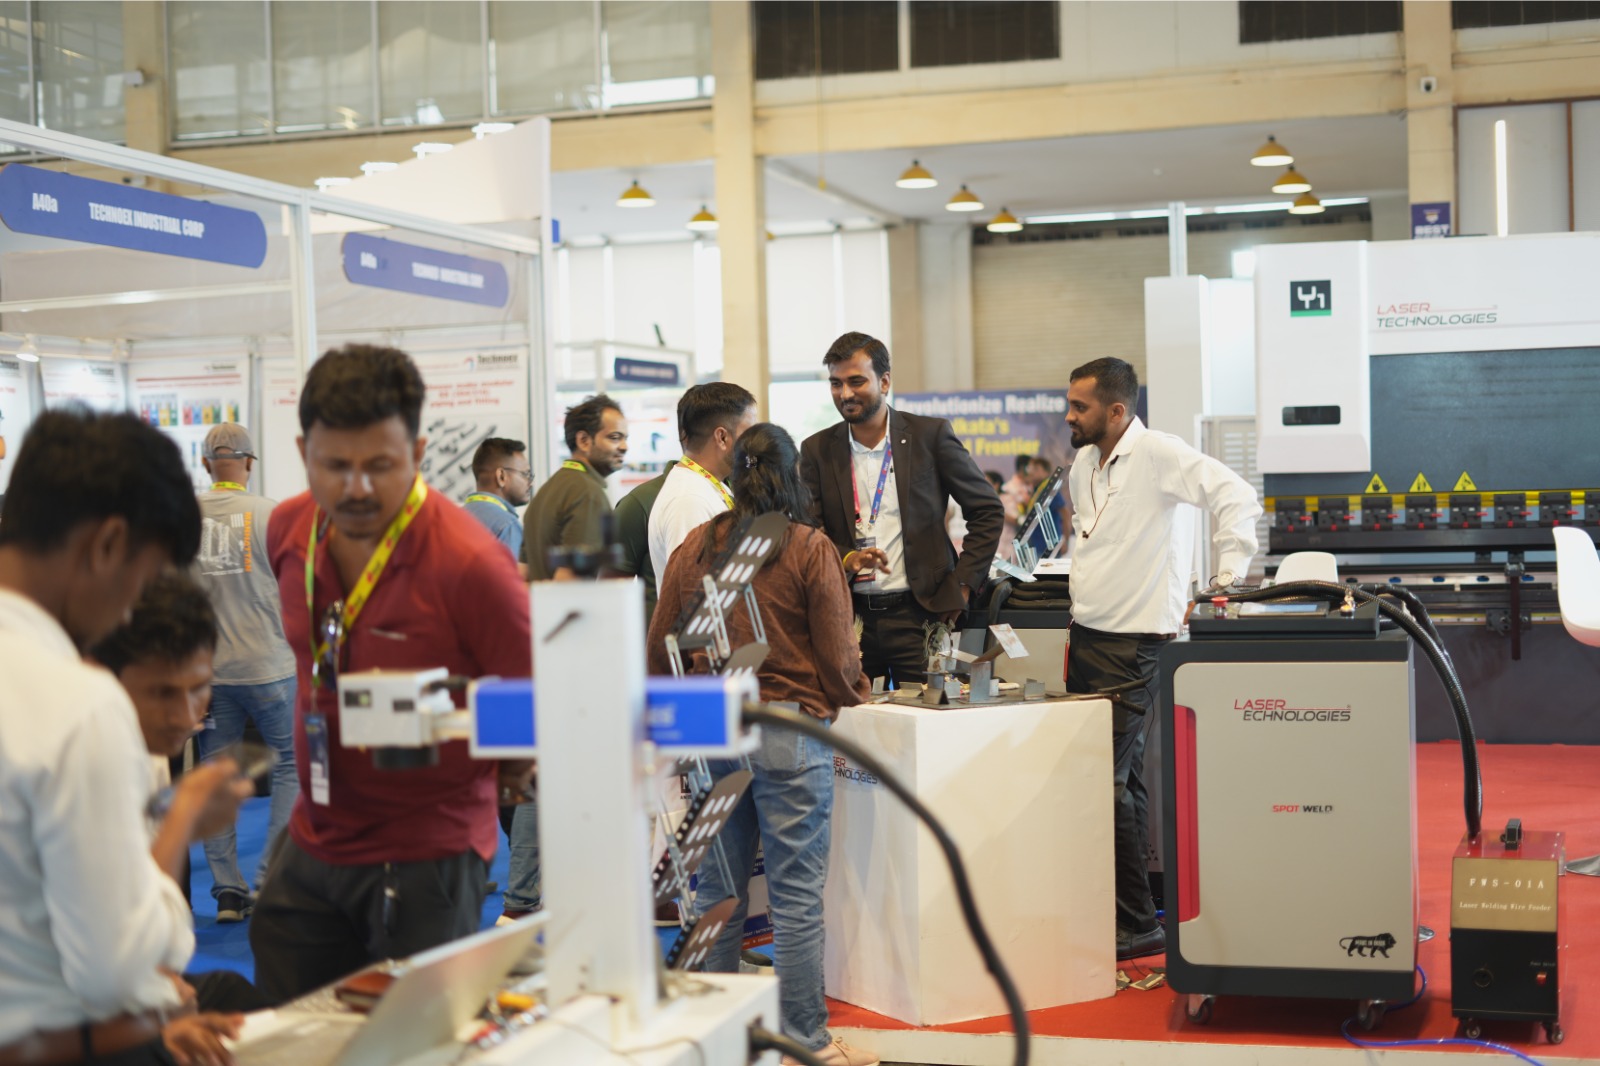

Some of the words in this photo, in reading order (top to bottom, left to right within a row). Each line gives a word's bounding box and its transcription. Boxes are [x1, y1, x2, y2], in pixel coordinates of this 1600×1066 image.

[88, 202, 133, 226] TECHNOEX
[133, 211, 182, 235] INDUSTRIAL
[182, 219, 205, 238] CORP
[1415, 224, 1449, 235] BEST
[1377, 303, 1431, 315] LASER
[1377, 313, 1498, 328] TECHNOLOGIES
[975, 437, 1041, 456] Frontier
[1234, 699, 1286, 710] LASER
[1243, 710, 1351, 721] ECHNOLOGIES
[1272, 805, 1299, 813] SPOT
[1460, 901, 1478, 909] Laser
[1481, 902, 1508, 911] Welding
[1528, 903, 1552, 911] Feeder
